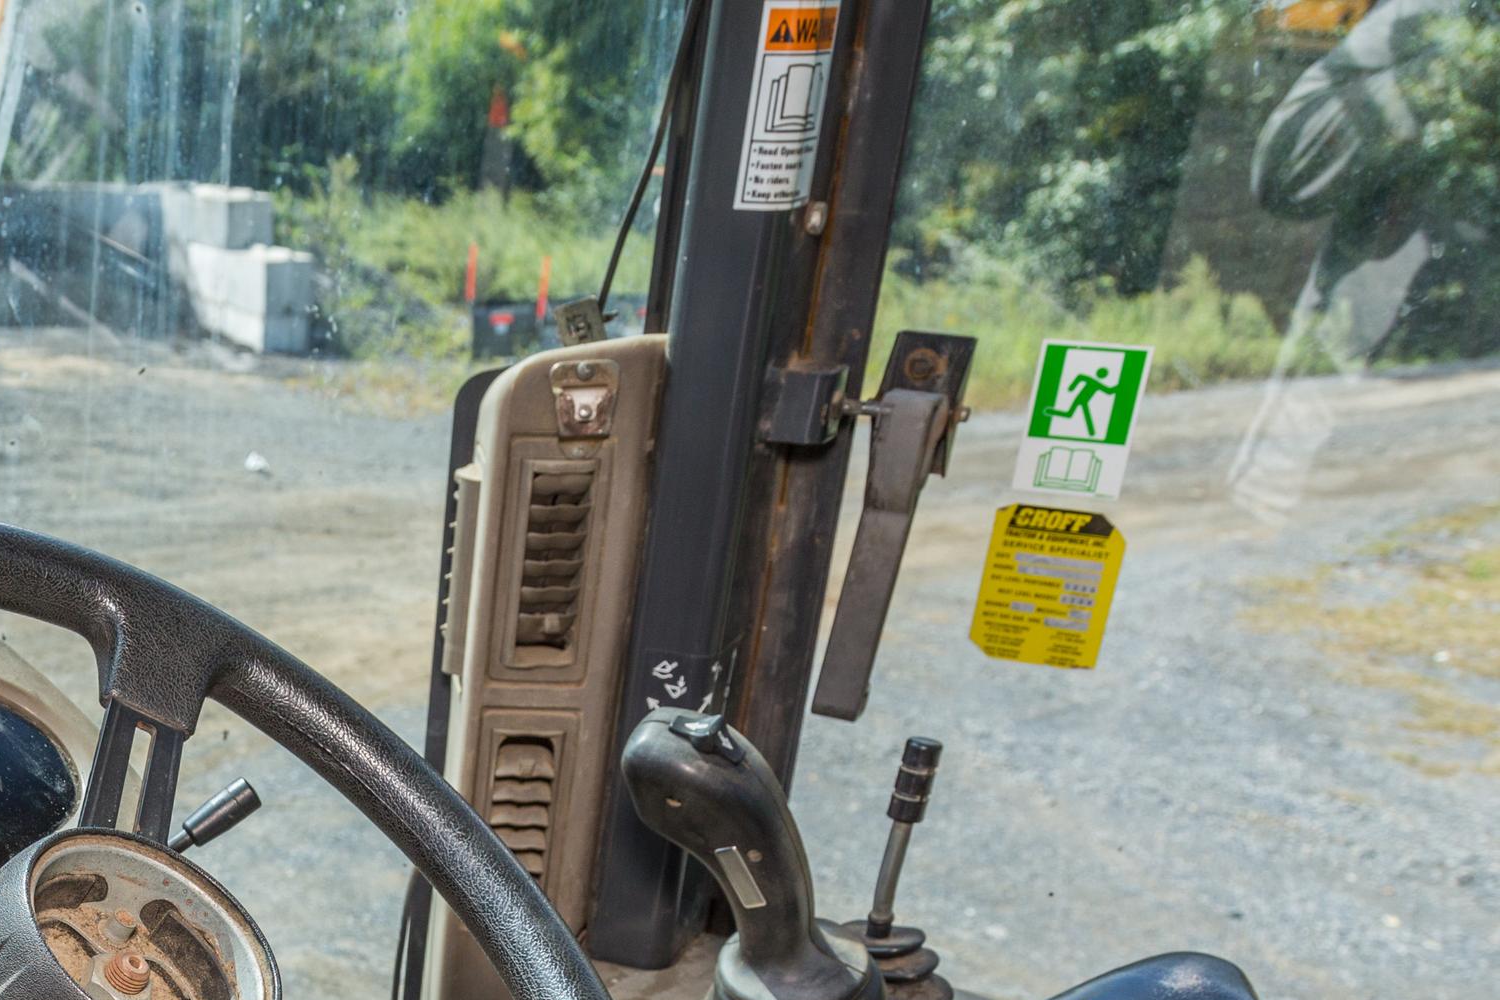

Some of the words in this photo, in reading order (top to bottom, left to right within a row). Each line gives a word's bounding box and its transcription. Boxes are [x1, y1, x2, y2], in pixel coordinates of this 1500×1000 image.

[1015, 507, 1092, 533] CROFF
[1003, 540, 1045, 552] SERVICE
[1050, 545, 1110, 559] SPECIALIST
